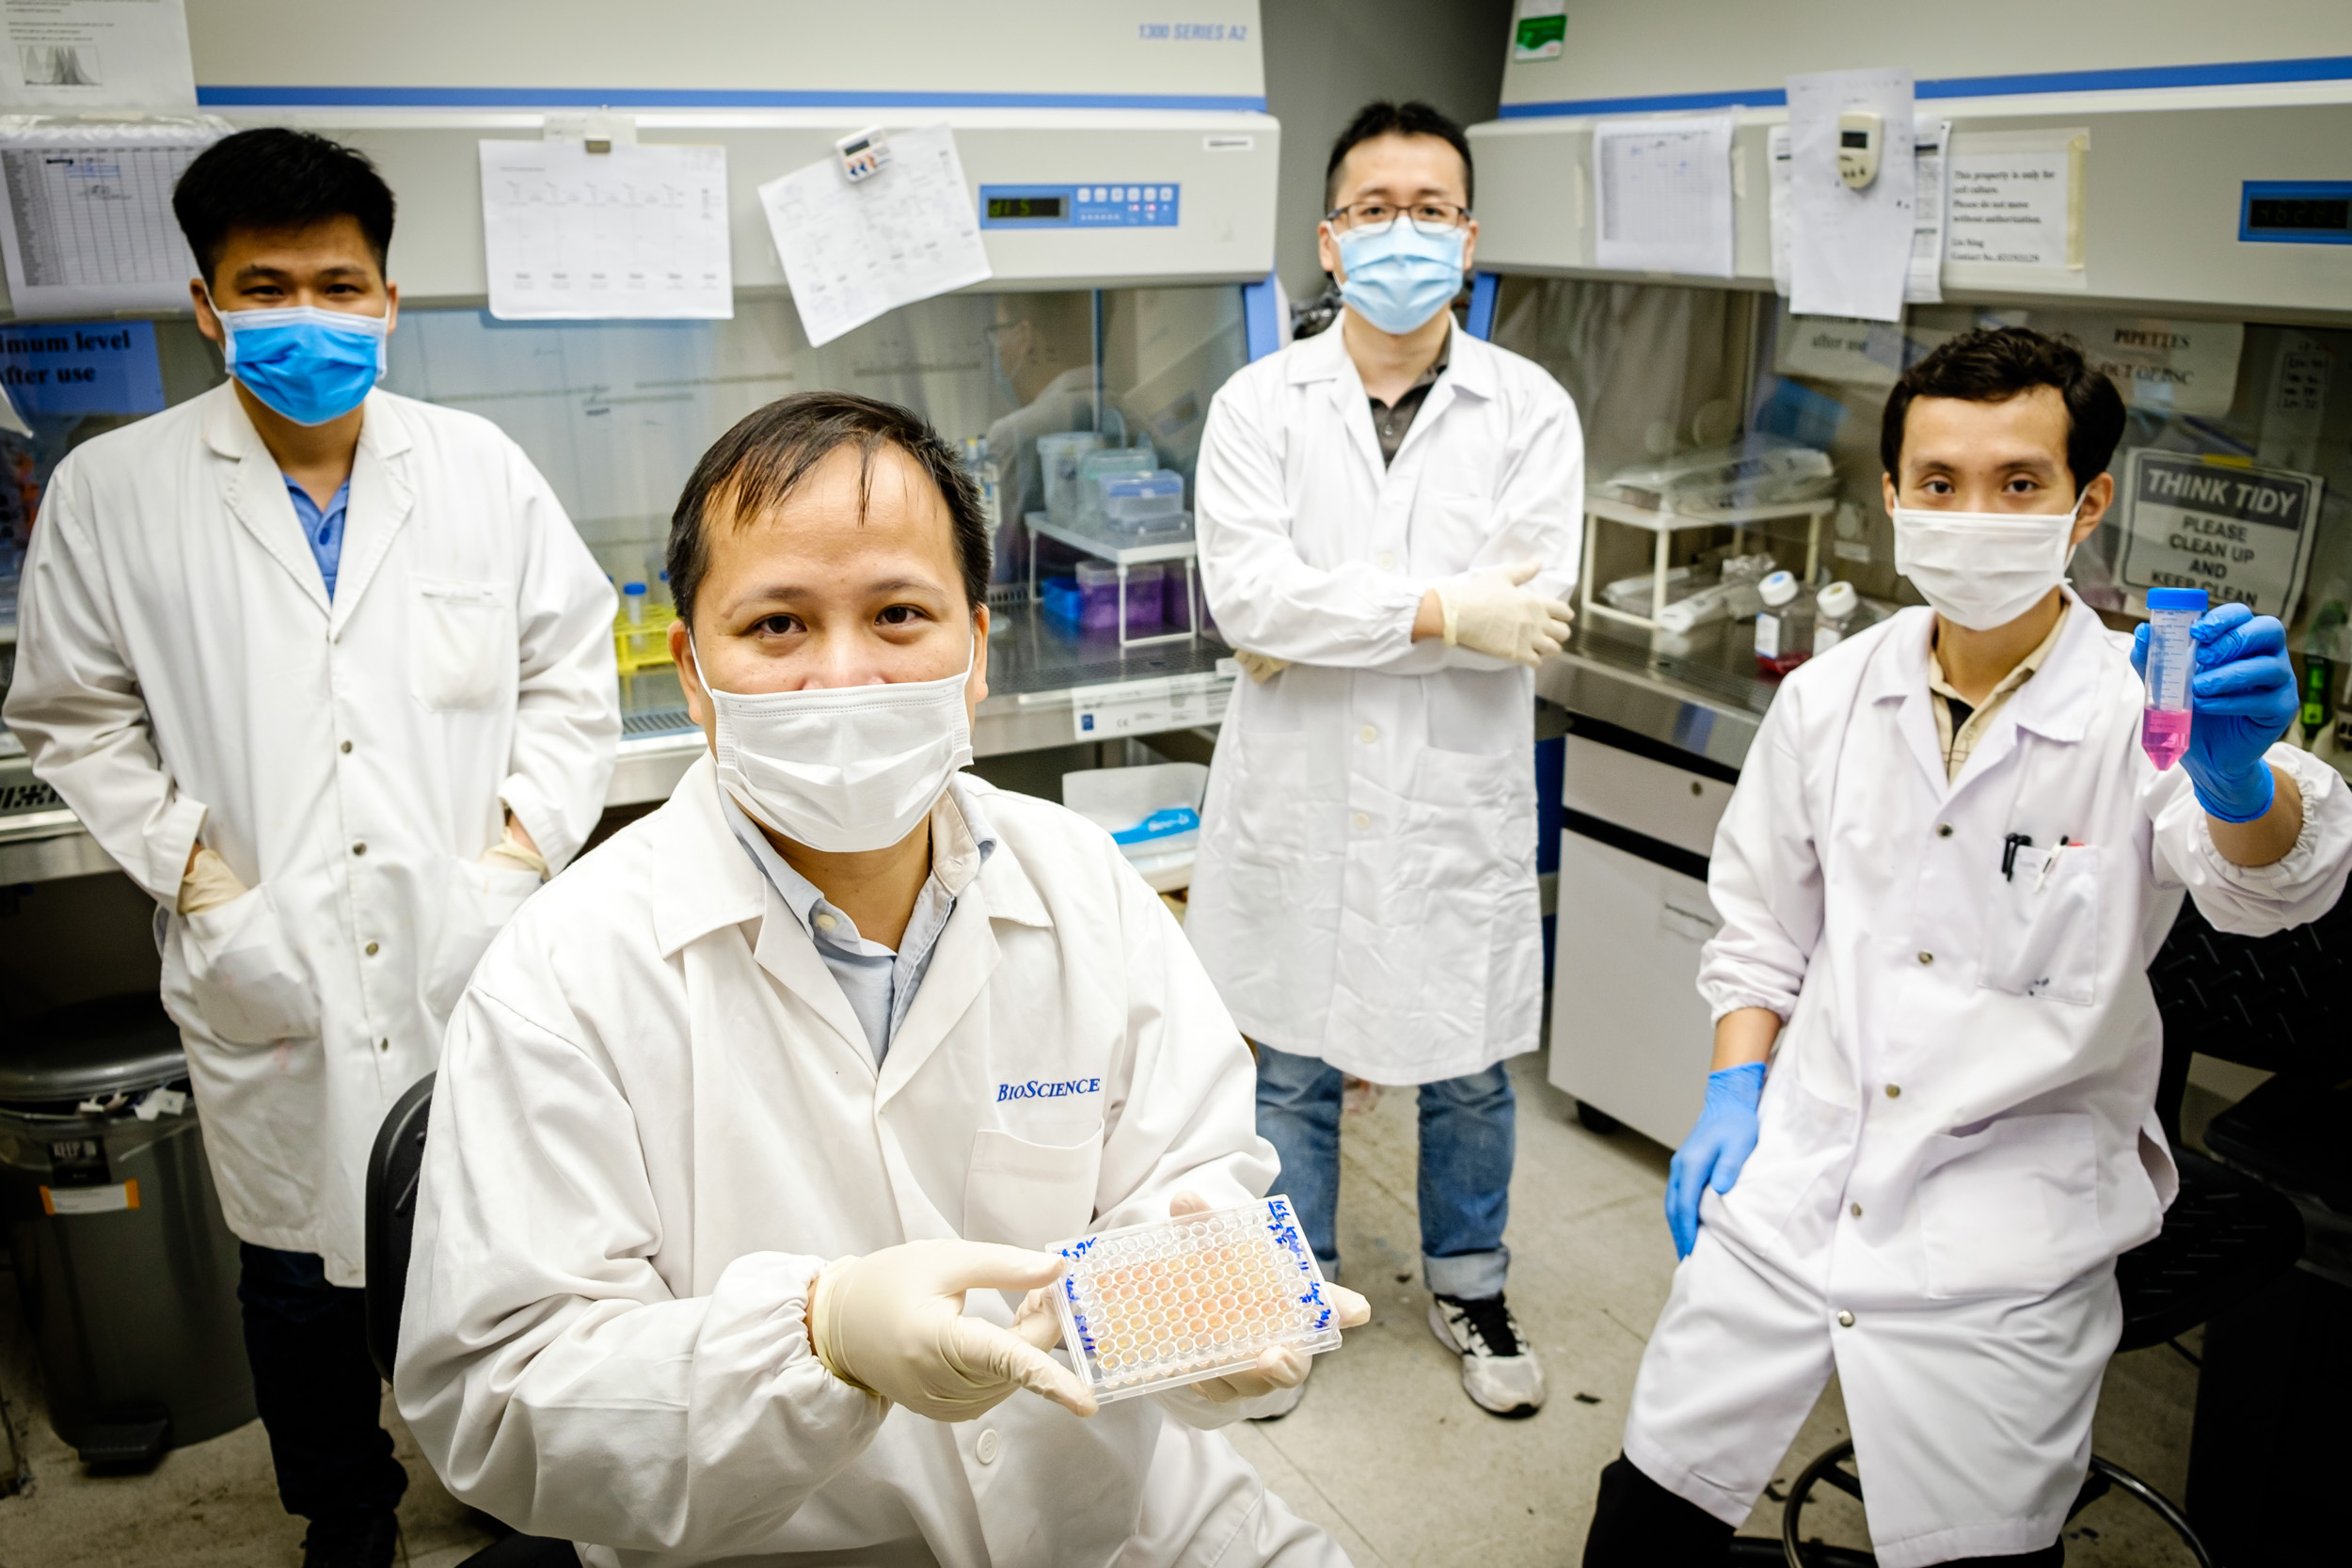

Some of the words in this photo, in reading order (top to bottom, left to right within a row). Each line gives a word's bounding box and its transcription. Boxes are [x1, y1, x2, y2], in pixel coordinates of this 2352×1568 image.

[1138, 24, 1169, 40] 1300
[1174, 24, 1224, 40] SERIES
[1228, 24, 1248, 41] A2
[1954, 170, 1971, 179] This
[1953, 199, 1977, 208] Please
[1980, 199, 1989, 208] do
[75, 329, 131, 352] level
[57, 366, 96, 383] use
[2147, 469, 2231, 506] THINK
[2234, 484, 2297, 516] TIDY
[2183, 515, 2249, 543] PLEASE
[2169, 534, 2227, 559] CLEAN
[2231, 546, 2255, 563] UP
[2188, 559, 2228, 579] AND
[2151, 570, 2197, 589] KEEP
[996, 1078, 1101, 1102] BIOSCIENCE
